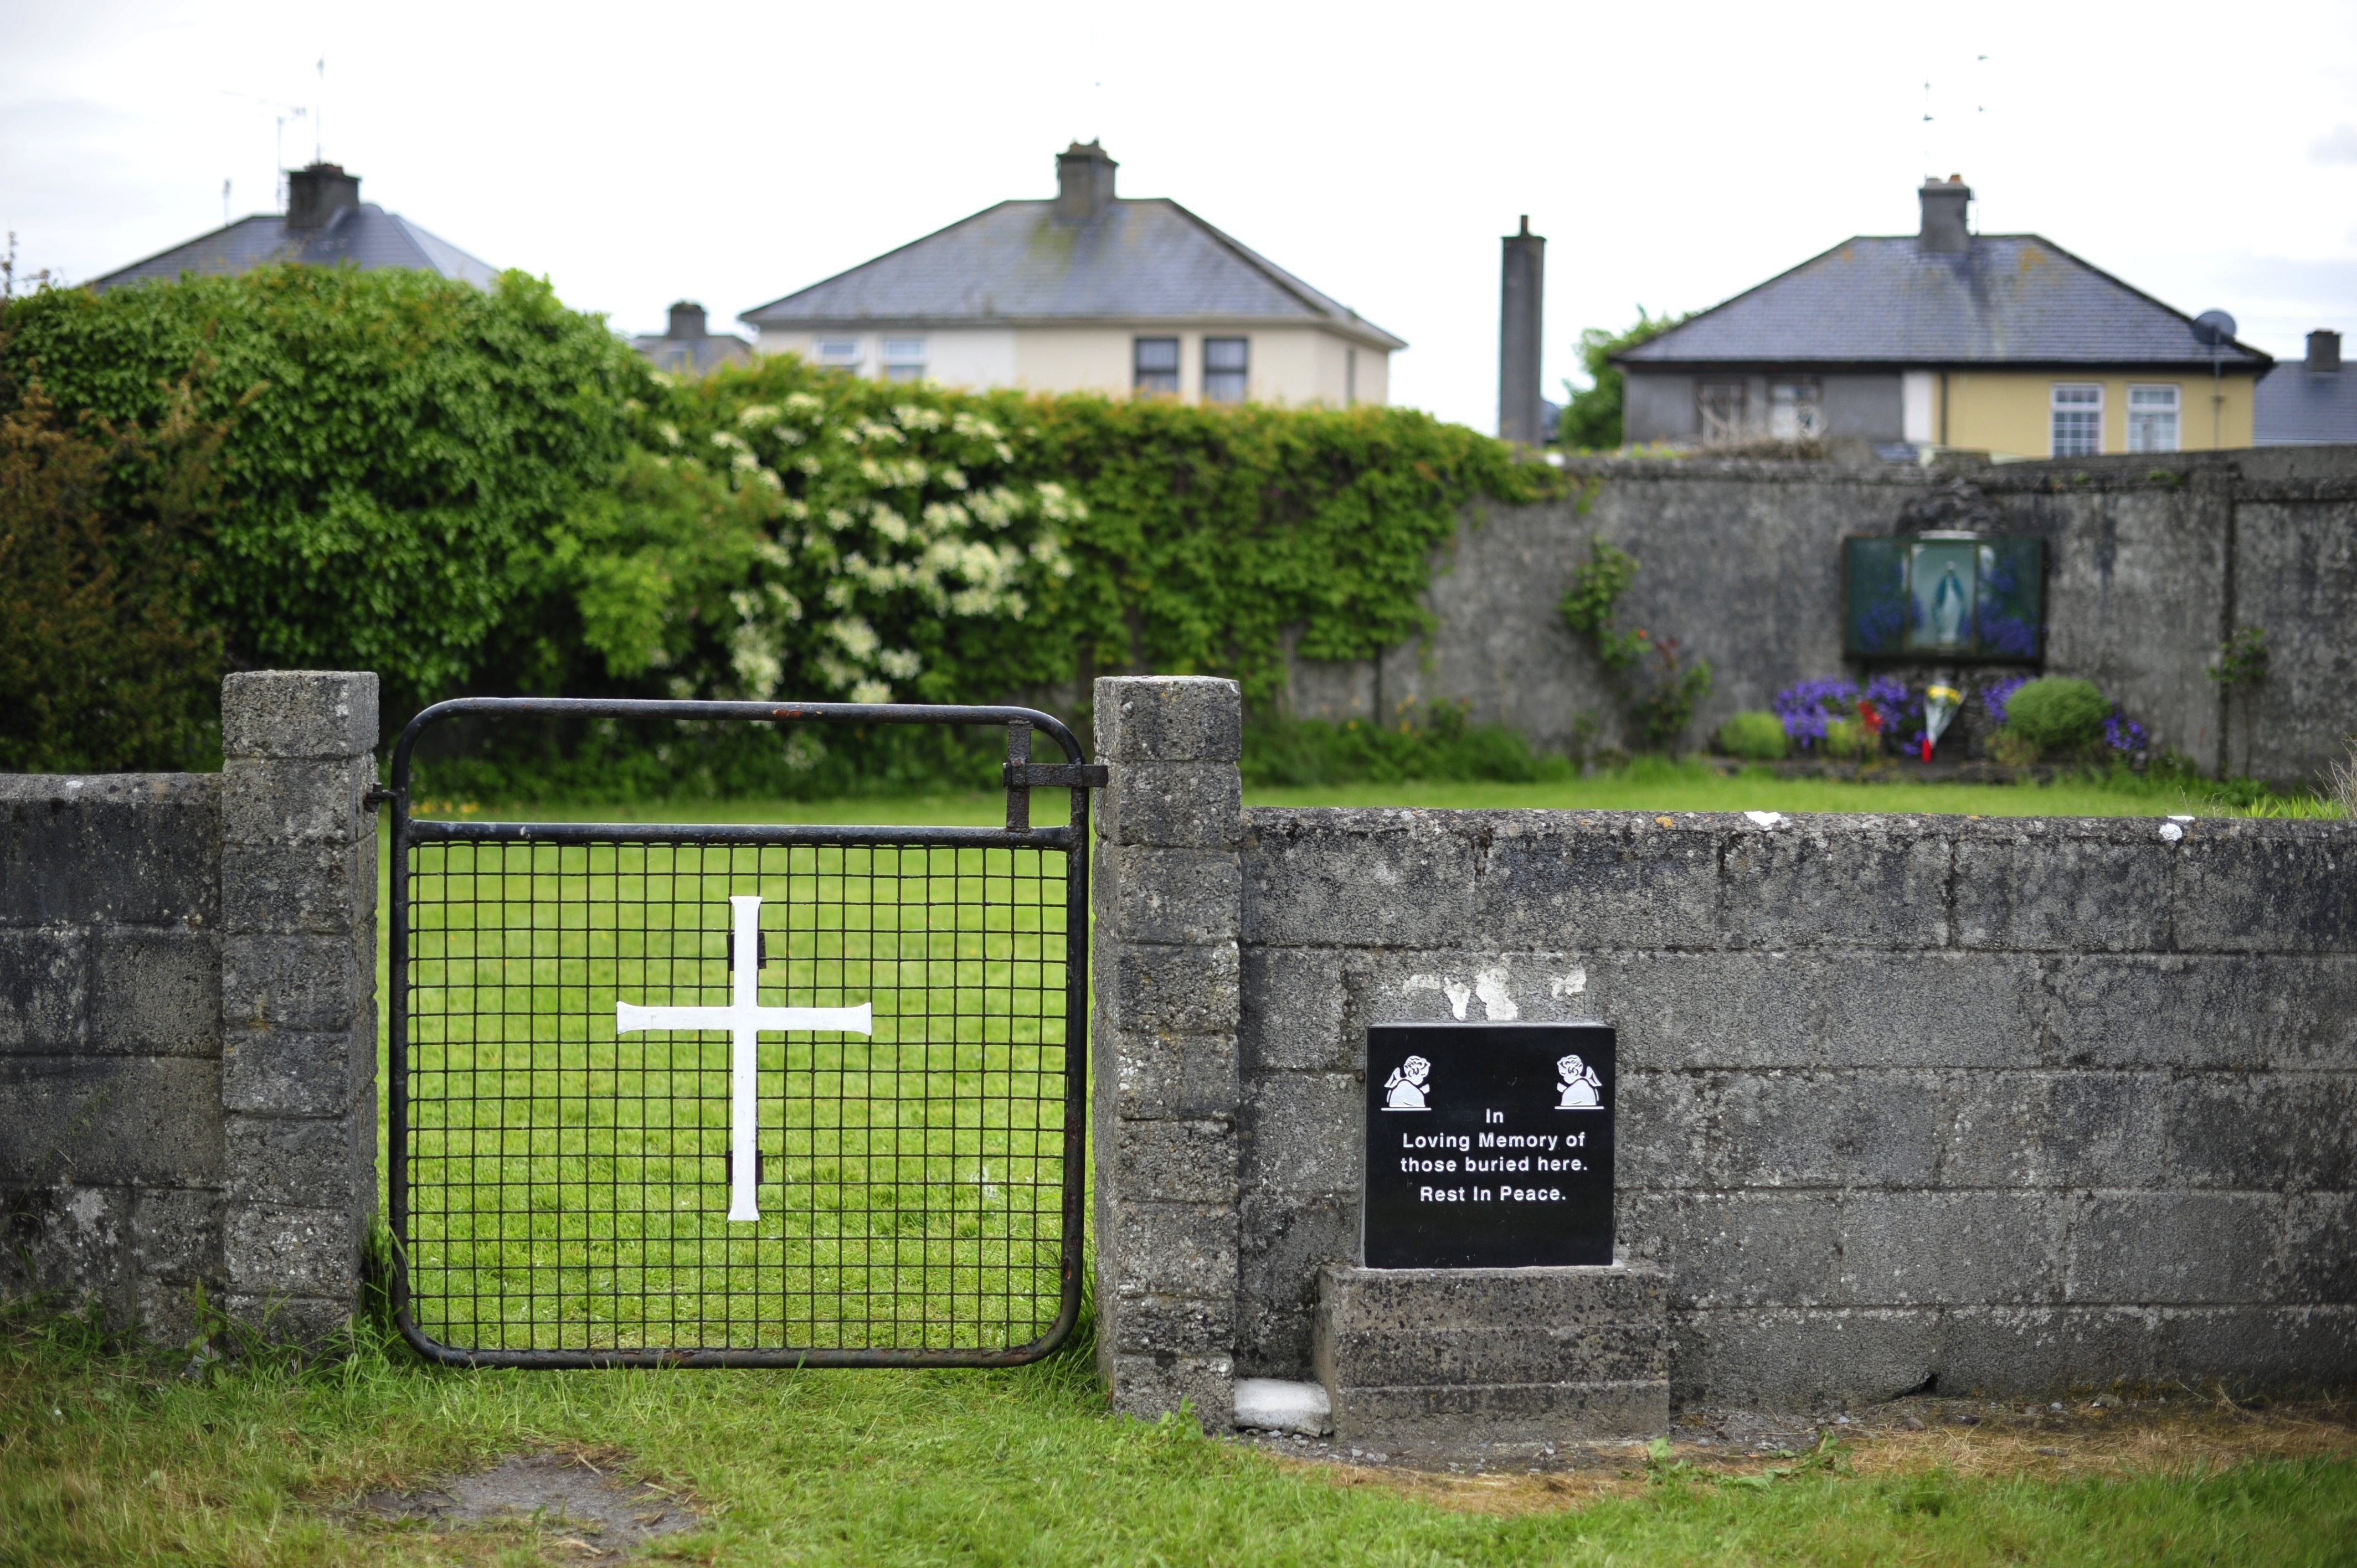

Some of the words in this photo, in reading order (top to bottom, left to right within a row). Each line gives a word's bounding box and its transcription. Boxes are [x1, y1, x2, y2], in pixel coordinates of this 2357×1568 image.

[1486, 1108, 1504, 1123] In
[1403, 1132, 1470, 1152] Loving
[1479, 1132, 1558, 1151] Memory
[1566, 1131, 1586, 1147] of
[1400, 1157, 1457, 1172] those
[1465, 1156, 1529, 1172] buried
[1537, 1156, 1588, 1172] here.
[1420, 1186, 1465, 1201] Rest
[1473, 1186, 1491, 1201] In
[1500, 1185, 1566, 1201] Peace.
